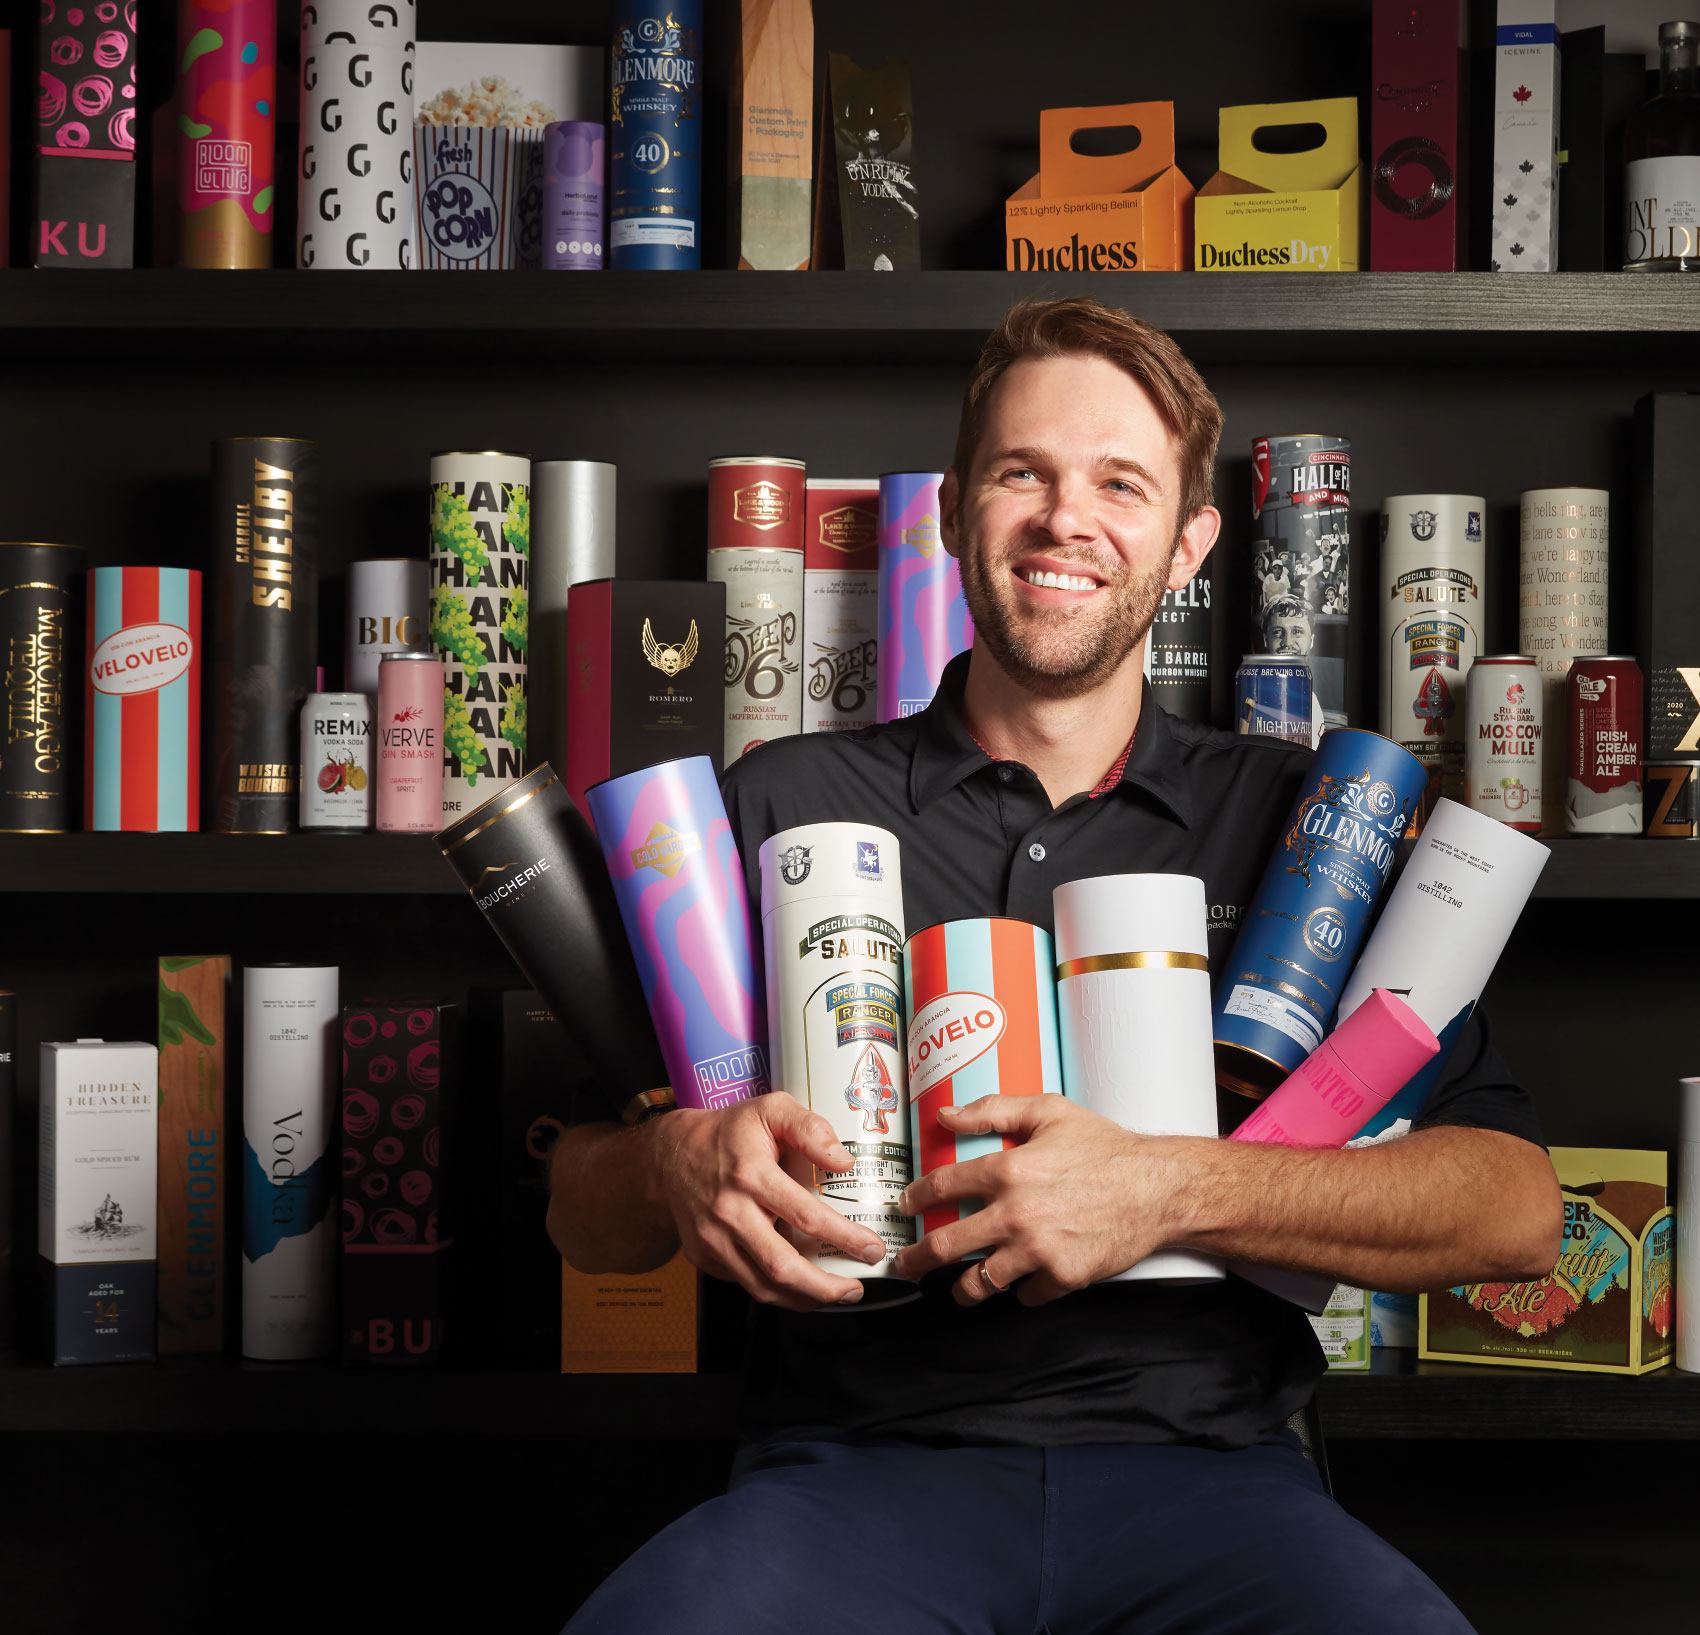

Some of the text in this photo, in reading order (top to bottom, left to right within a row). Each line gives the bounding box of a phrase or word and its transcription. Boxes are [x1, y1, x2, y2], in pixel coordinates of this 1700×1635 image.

[1515, 31, 1534, 39] VIDAL
[1504, 48, 1541, 56] ICEWINE
[623, 103, 677, 112] WHISKEY
[749, 116, 808, 128] Custom Print
[756, 128, 804, 140] Packaging
[436, 140, 472, 172] fresh
[635, 144, 660, 162] 40
[846, 164, 910, 184] UNRULY
[426, 180, 473, 219] POP
[1009, 199, 1138, 216] 12% Lightly Sparkling Bellini
[433, 207, 493, 248] CORN
[1012, 233, 1138, 271] Duchess
[1293, 464, 1342, 493] HALL OF
[1309, 491, 1328, 503] AND
[1534, 500, 1601, 520] bells ring, are
[236, 504, 250, 563] CARROLL
[252, 457, 294, 612] SHELBY
[1533, 522, 1597, 541] lane snow is
[1530, 545, 1594, 566] we're happy
[1399, 571, 1472, 587] SPECIAL OPERATIONS
[1537, 568, 1602, 585] Wonderland.
[1545, 590, 1605, 610] here to stay
[1408, 622, 1461, 637] SPECIAL FORCES
[1532, 611, 1604, 632] song while we
[1414, 638, 1455, 650] RANGER
[1524, 633, 1555, 650] Winter
[94, 641, 188, 680] VELOVELO
[1165, 651, 1208, 666] BARREL
[1414, 652, 1456, 667] AIRBORNE
[745, 649, 784, 701] 6
[808, 639, 878, 702] DEEP
[1184, 667, 1208, 678] WHISKEY
[1261, 668, 1307, 677] BREWING CO.
[1577, 675, 1590, 684] OLD
[1581, 682, 1599, 692] YALE
[5, 633, 37, 744] TEQUILA
[832, 671, 866, 713] 6
[744, 705, 776, 713] RUSSIAN
[1499, 706, 1531, 715] RUSSIAN
[729, 713, 789, 722] IMPERIAL STOUT
[1493, 713, 1535, 723] STANDARD
[315, 719, 370, 735] REMIX
[1479, 724, 1542, 740] MOSCOW
[383, 728, 434, 746] VERVE
[1596, 731, 1628, 742] IRISH
[382, 749, 435, 759] GIN SMASH
[1492, 741, 1535, 756] MULE
[1596, 742, 1637, 754] CREAM
[1596, 754, 1637, 765] AMBER
[1596, 766, 1621, 776] ALE
[636, 847, 659, 864] COLD
[1453, 853, 1466, 861] ROCKY
[1467, 860, 1490, 874] MOUNTAINS
[1481, 860, 1495, 869] COAST
[1317, 864, 1373, 904] WHISKEY
[1329, 861, 1372, 891] SINGLE MALT
[1417, 882, 1463, 908] DISTILLING
[1433, 880, 1453, 894] 1042
[1325, 914, 1343, 926] AGED
[813, 919, 854, 938] SPECIAL
[1314, 920, 1342, 948] 40
[821, 938, 898, 965] SALUTE
[1313, 939, 1333, 955] YEARS
[832, 986, 897, 1008] SPECIAL FORCES
[842, 1006, 892, 1019] RANGER
[925, 1007, 951, 1028] ARANCIA
[842, 1026, 893, 1044] AIRBORNE
[79, 1083, 141, 1093] HIDDEN
[66, 1096, 151, 1106] TREASURE
[866, 1145, 883, 1155] SOF
[272, 1109, 305, 1224] Vodka
[855, 1160, 889, 1168] STRAIGHT
[827, 1183, 845, 1191] 52.5%
[845, 1182, 858, 1190] ALC.
[187, 1128, 217, 1324] GLENMORE
[1483, 1281, 1546, 1314] Ale
